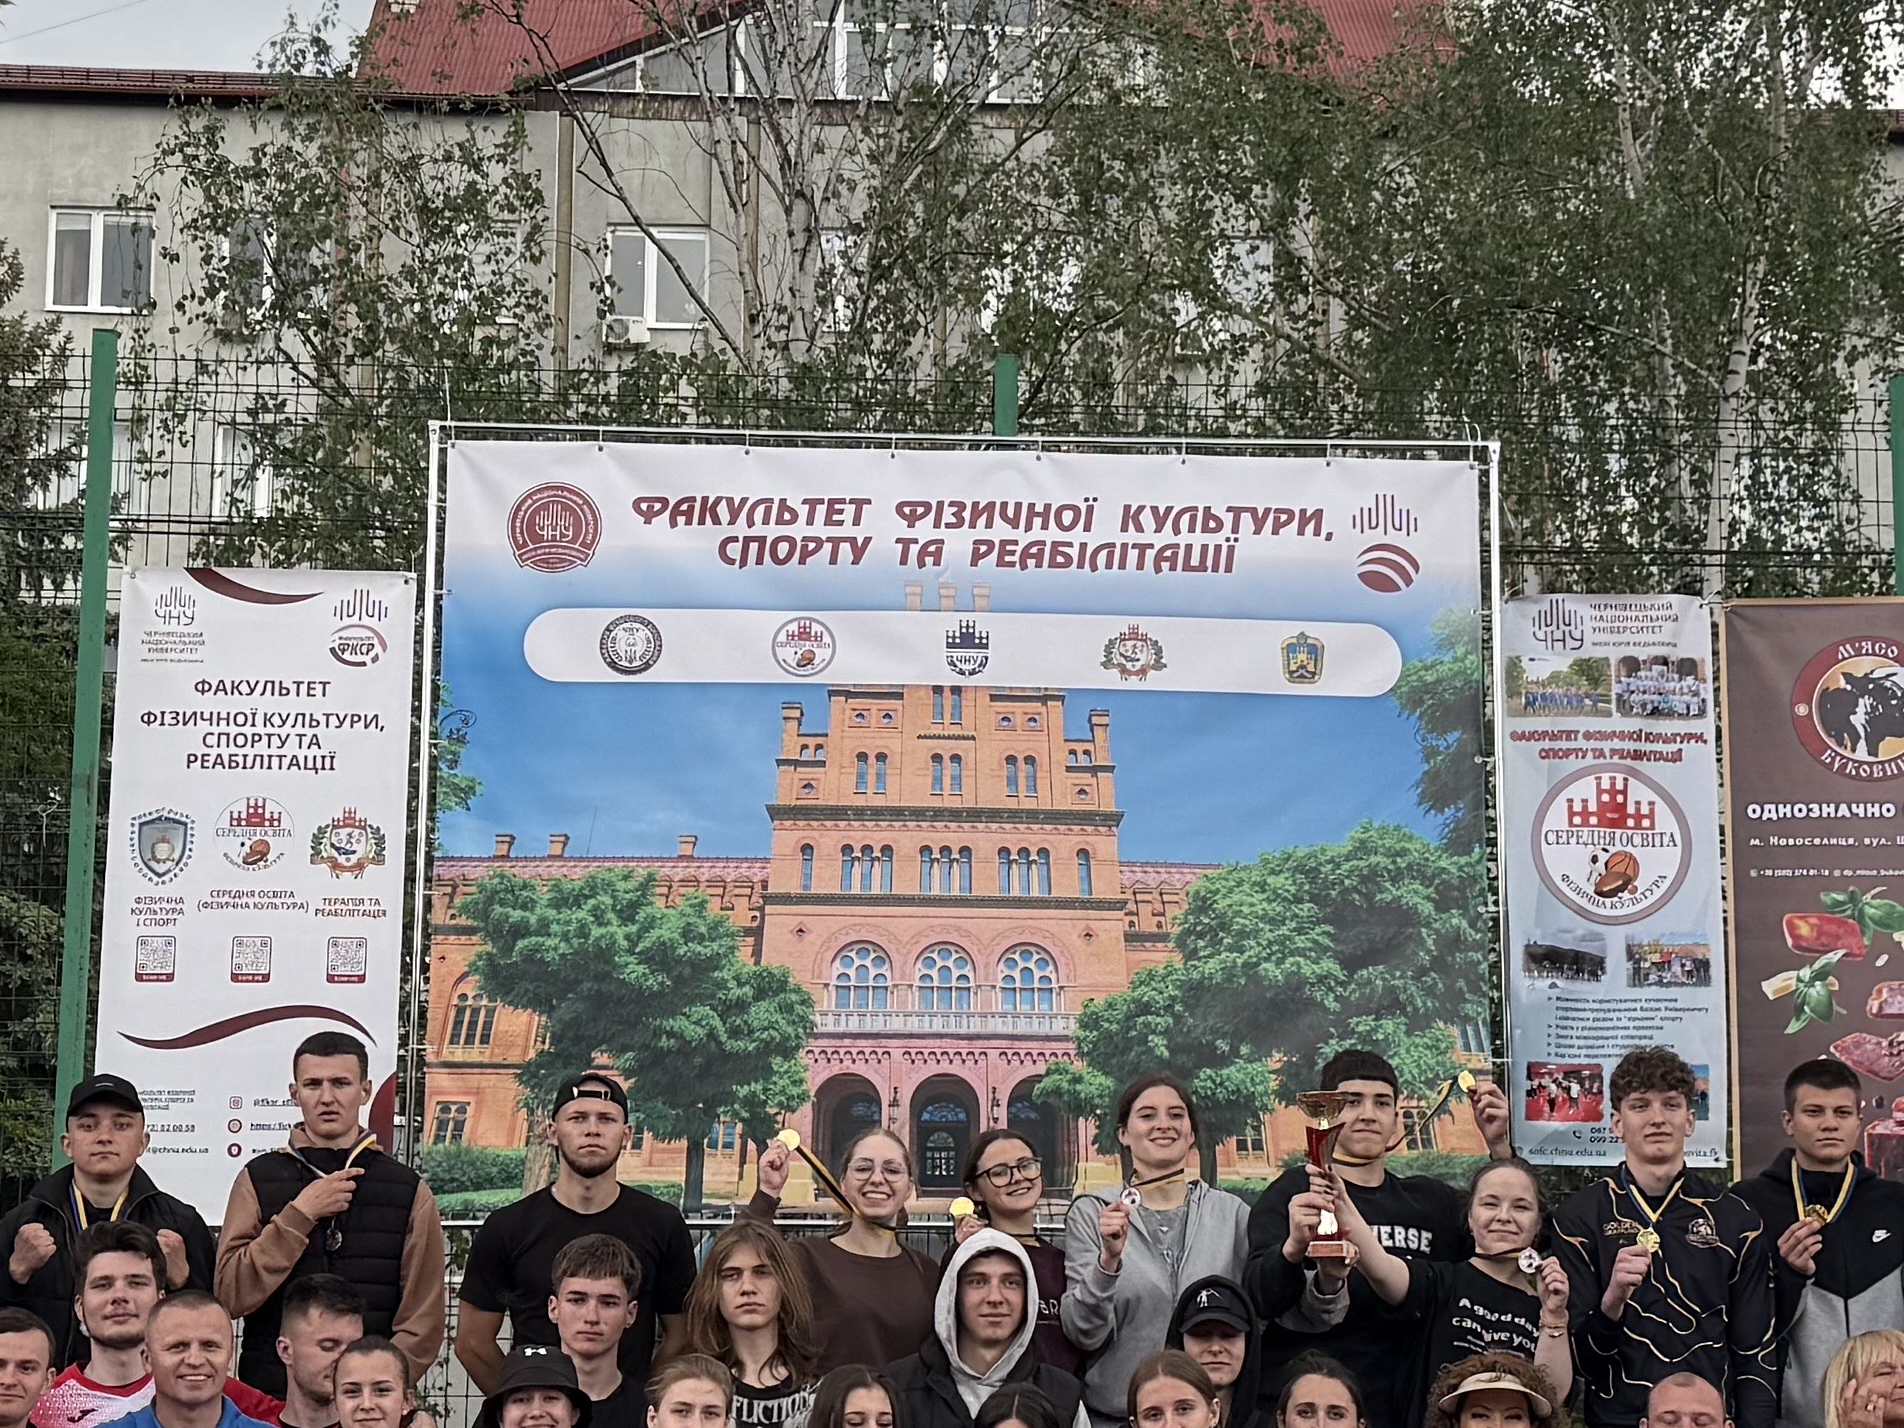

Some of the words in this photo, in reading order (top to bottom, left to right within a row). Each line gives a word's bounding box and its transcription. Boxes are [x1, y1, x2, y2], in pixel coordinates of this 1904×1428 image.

[632, 495, 872, 529] ФАКУЛЬТЕТ
[895, 497, 1098, 533] ФІЗИЧНОЇ
[1121, 504, 1335, 543] КУЛЬТУРИ,
[718, 534, 872, 570] СПОРТУ
[896, 538, 944, 568] ТА
[970, 537, 1238, 574] РЕАБІЛІТАЦІЇ
[194, 679, 331, 697] ФАКУЛЬТЕТ
[140, 708, 258, 728] ФІЗИЧНОЇ
[263, 712, 385, 732] КУЛЬТУРИ,
[202, 732, 290, 750] СПОРТУ
[295, 734, 322, 750] ТА
[186, 751, 337, 774] РЕАБІЛІТАЦІЇ
[1746, 803, 1896, 821] ОДНОЗНАЧНО
[1544, 829, 1616, 848] СЕРЕДНЯ
[1619, 831, 1678, 848] ОСВІТА
[1769, 836, 1859, 848] Новоселиця,
[1864, 837, 1892, 849] вул.
[1560, 872, 1607, 910] ФІЗИЧНА
[1609, 873, 1668, 910] КУЛЬТУРА
[367, 897, 382, 907] ТА
[130, 907, 185, 918] КУЛЬТУРА
[142, 918, 179, 927] СПОРТ
[1459, 1298, 1472, 1308] A
[1452, 1317, 1481, 1333] can
[732, 1392, 809, 1424] FLICTION
